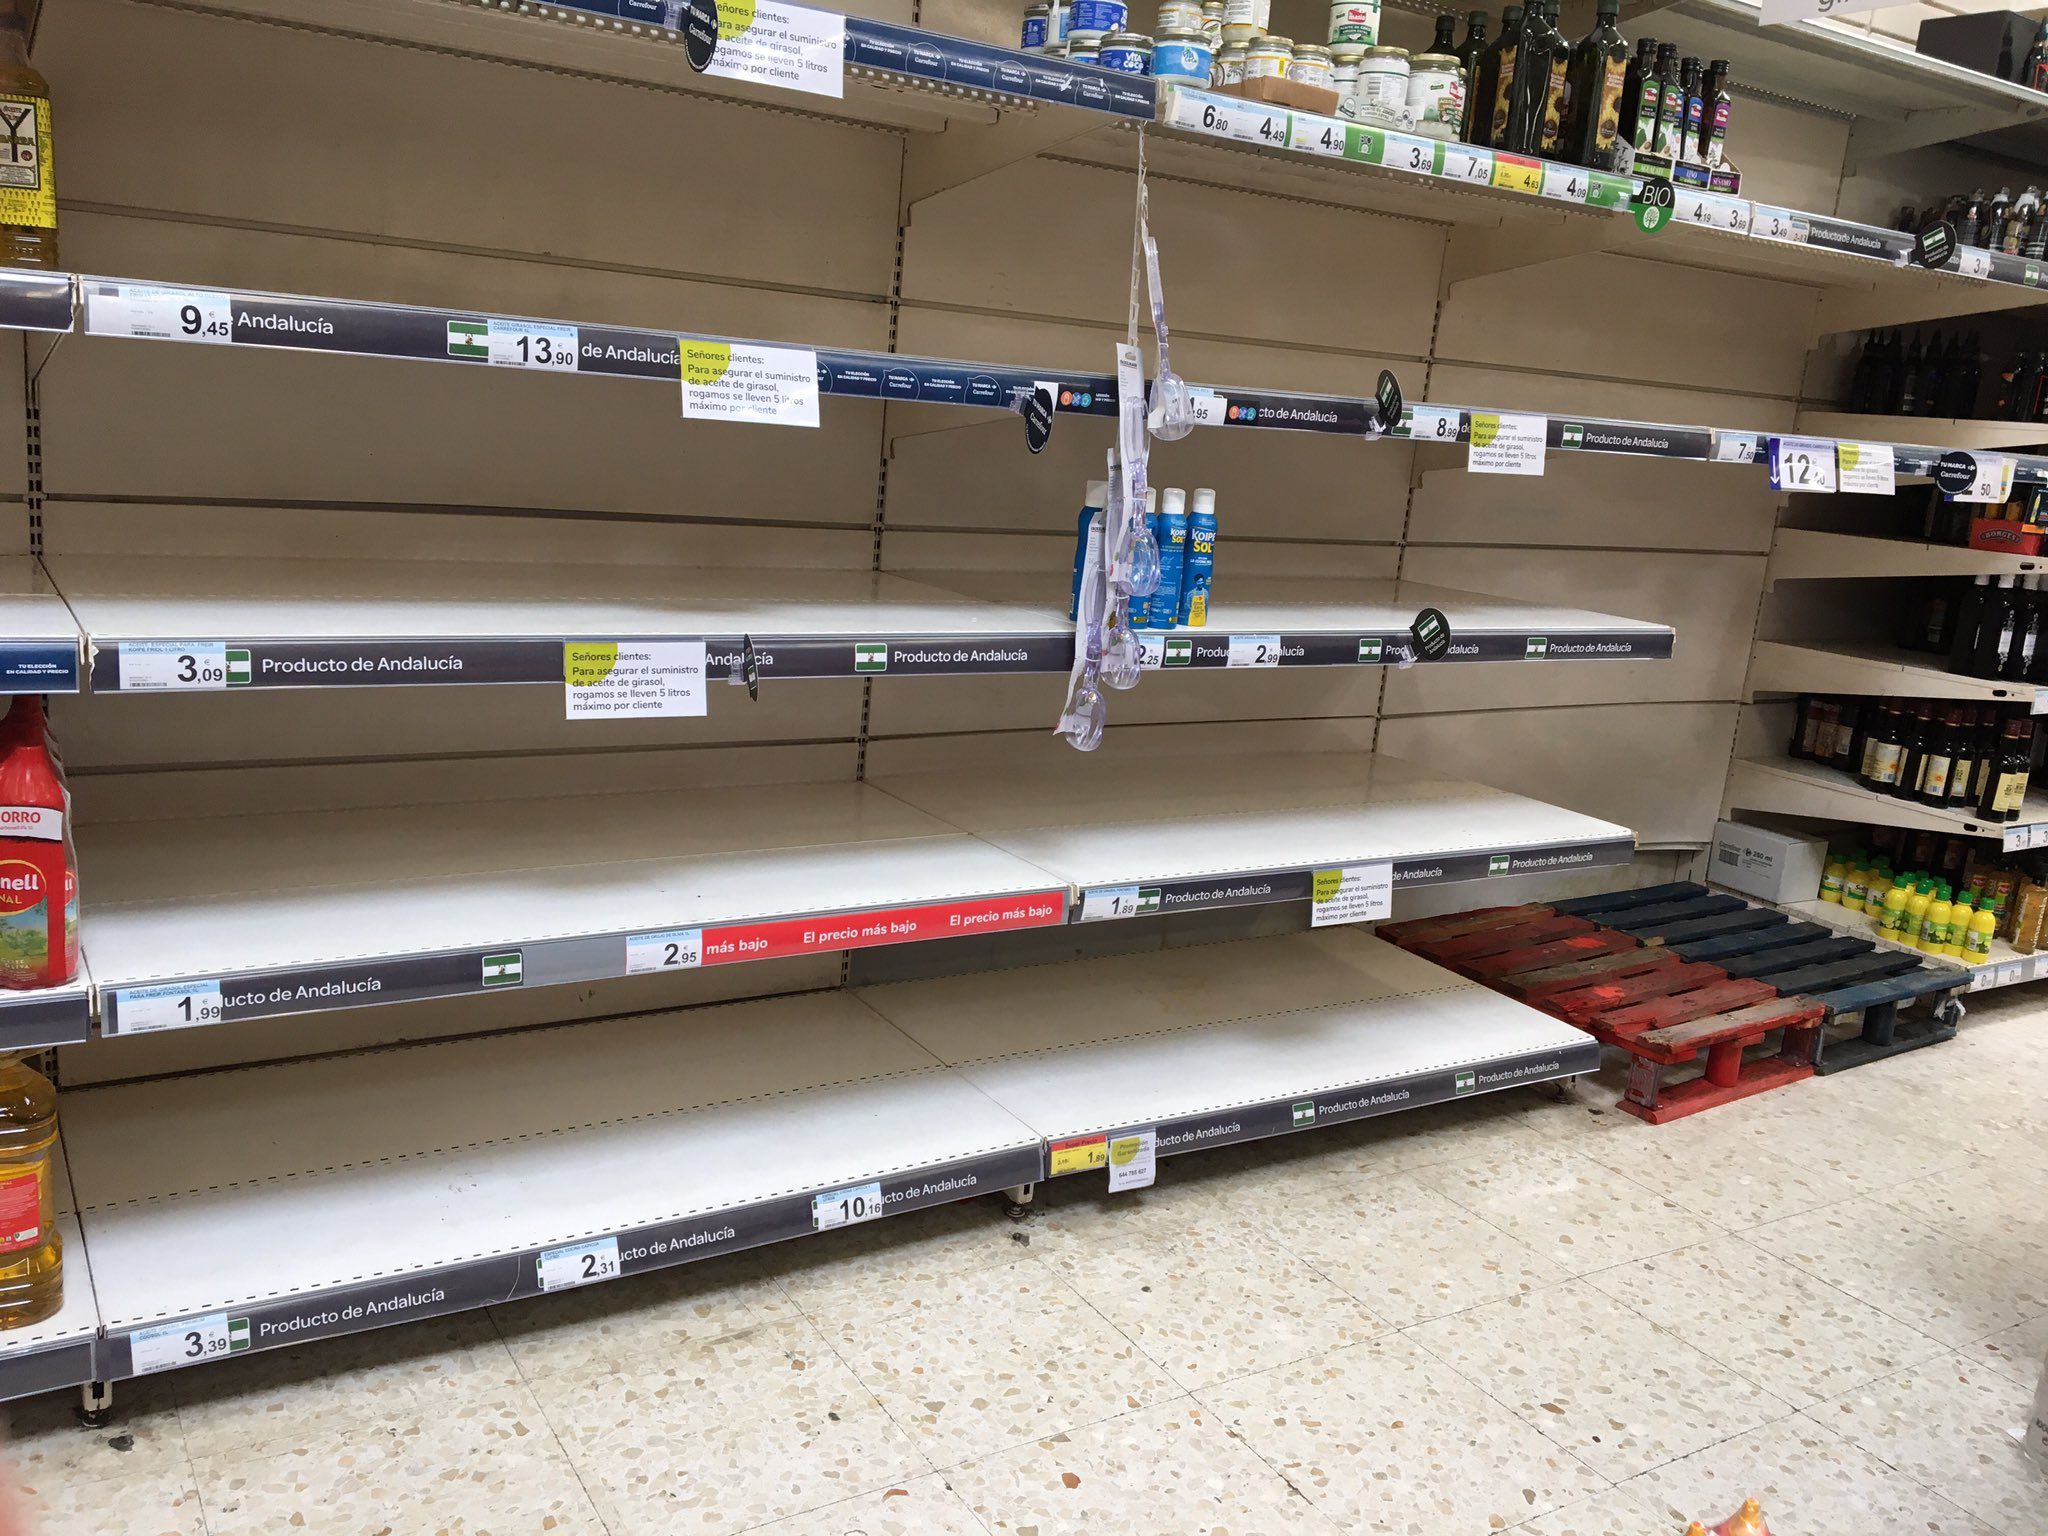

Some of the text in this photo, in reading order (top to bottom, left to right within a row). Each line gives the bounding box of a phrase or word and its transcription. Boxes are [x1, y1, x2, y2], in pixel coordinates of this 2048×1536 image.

[752, 10, 789, 24] clientes:
[734, 25, 777, 37] asegurar
[750, 65, 800, 80] por cliente
[805, 60, 828, 73] litros
[1202, 105, 1228, 131] 6,80
[1259, 117, 1285, 142] 4,49
[1320, 127, 1344, 151] 4,90
[1410, 147, 1431, 171] 3,69
[1468, 156, 1488, 179] 7,05
[1566, 177, 1586, 200] 4,09
[1642, 185, 1671, 207] BIO
[180, 305, 228, 337] 9,45
[237, 311, 334, 335] Andalucía
[516, 335, 573, 366] 13,90
[581, 343, 681, 366] de Andalucía
[686, 349, 765, 365] Señores clientes:
[687, 364, 811, 383] Para asegurar el suministro
[688, 377, 779, 393] de aceite de girasol,
[689, 389, 780, 404] rogamos se lleven 5
[689, 401, 727, 411] máximo
[1276, 408, 1338, 423] de Andalucía
[1474, 420, 1497, 429] Señores
[1436, 418, 1457, 438] 8,99
[1517, 435, 1543, 443] suministro
[1586, 432, 1669, 449] Producto de Andalucía
[1472, 458, 1522, 468] máximo cliente
[1948, 462, 1966, 470] MARCA
[1940, 470, 1971, 480] Carrefour
[1193, 541, 1213, 553] SOL
[572, 651, 652, 661] Señores clientes:
[894, 648, 1028, 663] Producto de Andalucía
[1255, 644, 1278, 664] 2,99
[1550, 642, 1632, 653] Producto Andalucía
[177, 654, 223, 684] 3,09
[262, 655, 464, 673] Producto de Andalucía
[572, 665, 699, 677] Para asegurar el suministro
[572, 677, 665, 689] de aceite de girasol,
[573, 688, 691, 700] rogamos se lleven 5 litros
[573, 700, 663, 712] máximo por cliente
[1, 811, 41, 824] ORRO
[1512, 852, 1594, 869] Producto de Andalucía
[0, 873, 39, 891] nell
[1316, 878, 1339, 886] Señores
[1402, 866, 1443, 880] Andalucía
[1165, 883, 1272, 904] Producto de Andalucía
[1316, 883, 1388, 897] Para suministro
[1349, 893, 1369, 902] girasol,
[1111, 896, 1134, 915] 1,89
[1316, 905, 1340, 914] rogamos
[1348, 902, 1364, 910] lleven
[950, 904, 1053, 927] El precio más bajo
[1316, 910, 1367, 922] máximo por cliente
[803, 919, 917, 944] El precio más bajo
[664, 943, 697, 967] 2,95
[706, 937, 768, 955] más bajo
[269, 977, 382, 1005] de Andalucía
[177, 996, 220, 1022] 1,99
[1478, 1061, 1560, 1084] Producto de Andalucía
[1318, 1090, 1410, 1116] Producto de Andalucía
[1182, 1121, 1241, 1143] de Andalucía
[1087, 1151, 1105, 1164] 1,89
[905, 1174, 977, 1199] de Andalucía
[839, 1196, 881, 1220] 10,16
[649, 1226, 735, 1256] de Andalucía
[581, 1254, 614, 1279] 2,31
[260, 1288, 446, 1336] Producto de Andalucía
[184, 1331, 227, 1357] 3,39
